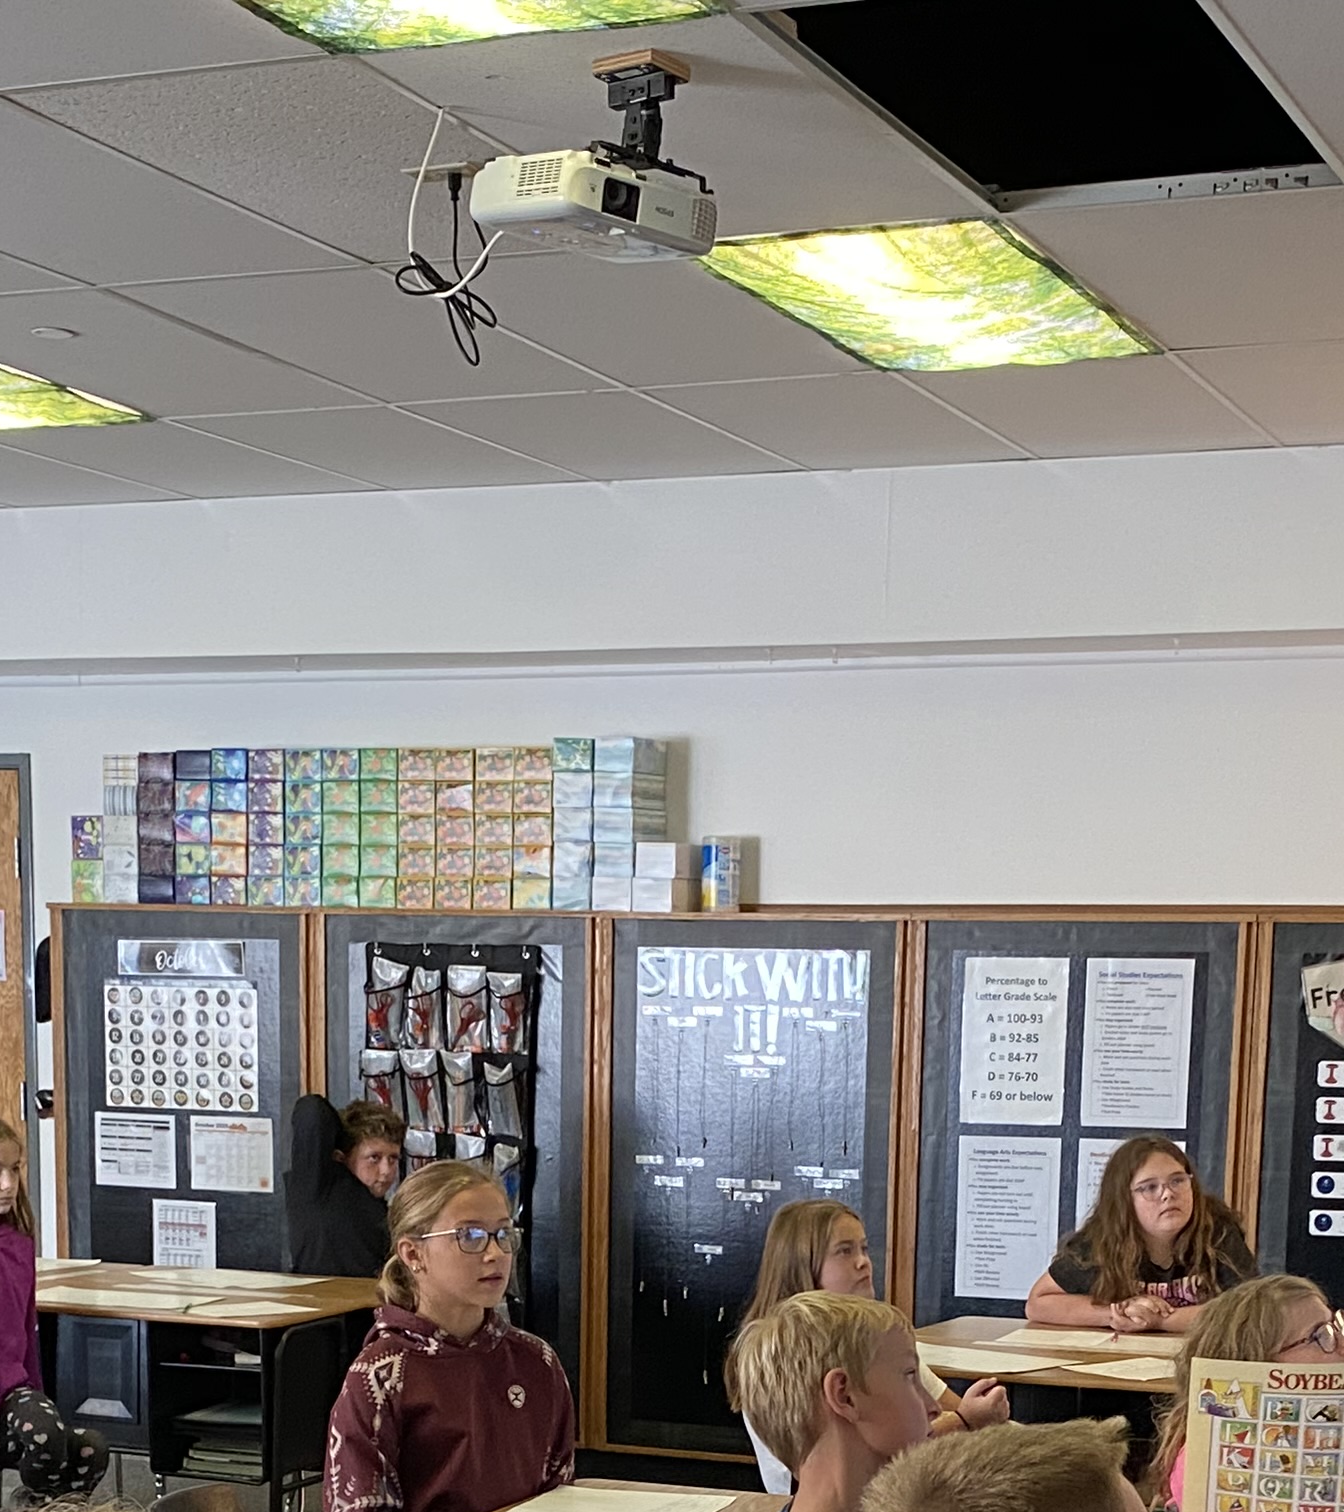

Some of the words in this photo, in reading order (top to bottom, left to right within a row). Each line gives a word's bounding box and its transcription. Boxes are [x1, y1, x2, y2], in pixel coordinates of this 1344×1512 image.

[638, 947, 748, 1000] STICK
[985, 976, 1033, 988] Percentage
[1036, 977, 1048, 986] to
[975, 991, 1002, 1001] Letter
[1005, 991, 1030, 1001] Grade
[1033, 992, 1058, 1002] Scale
[986, 1013, 995, 1024] A
[1007, 1013, 1043, 1024] 100-93
[733, 1004, 779, 1054] IT!
[989, 1033, 997, 1043] B
[1008, 1033, 1039, 1043] 92-85
[989, 1052, 997, 1062] C
[1008, 1052, 1038, 1062] 84-77
[987, 1072, 996, 1082] D
[1008, 1072, 1039, 1082] 76-70
[971, 1091, 978, 1101] F
[989, 1091, 1002, 1101] 69
[1019, 1091, 1053, 1102] below
